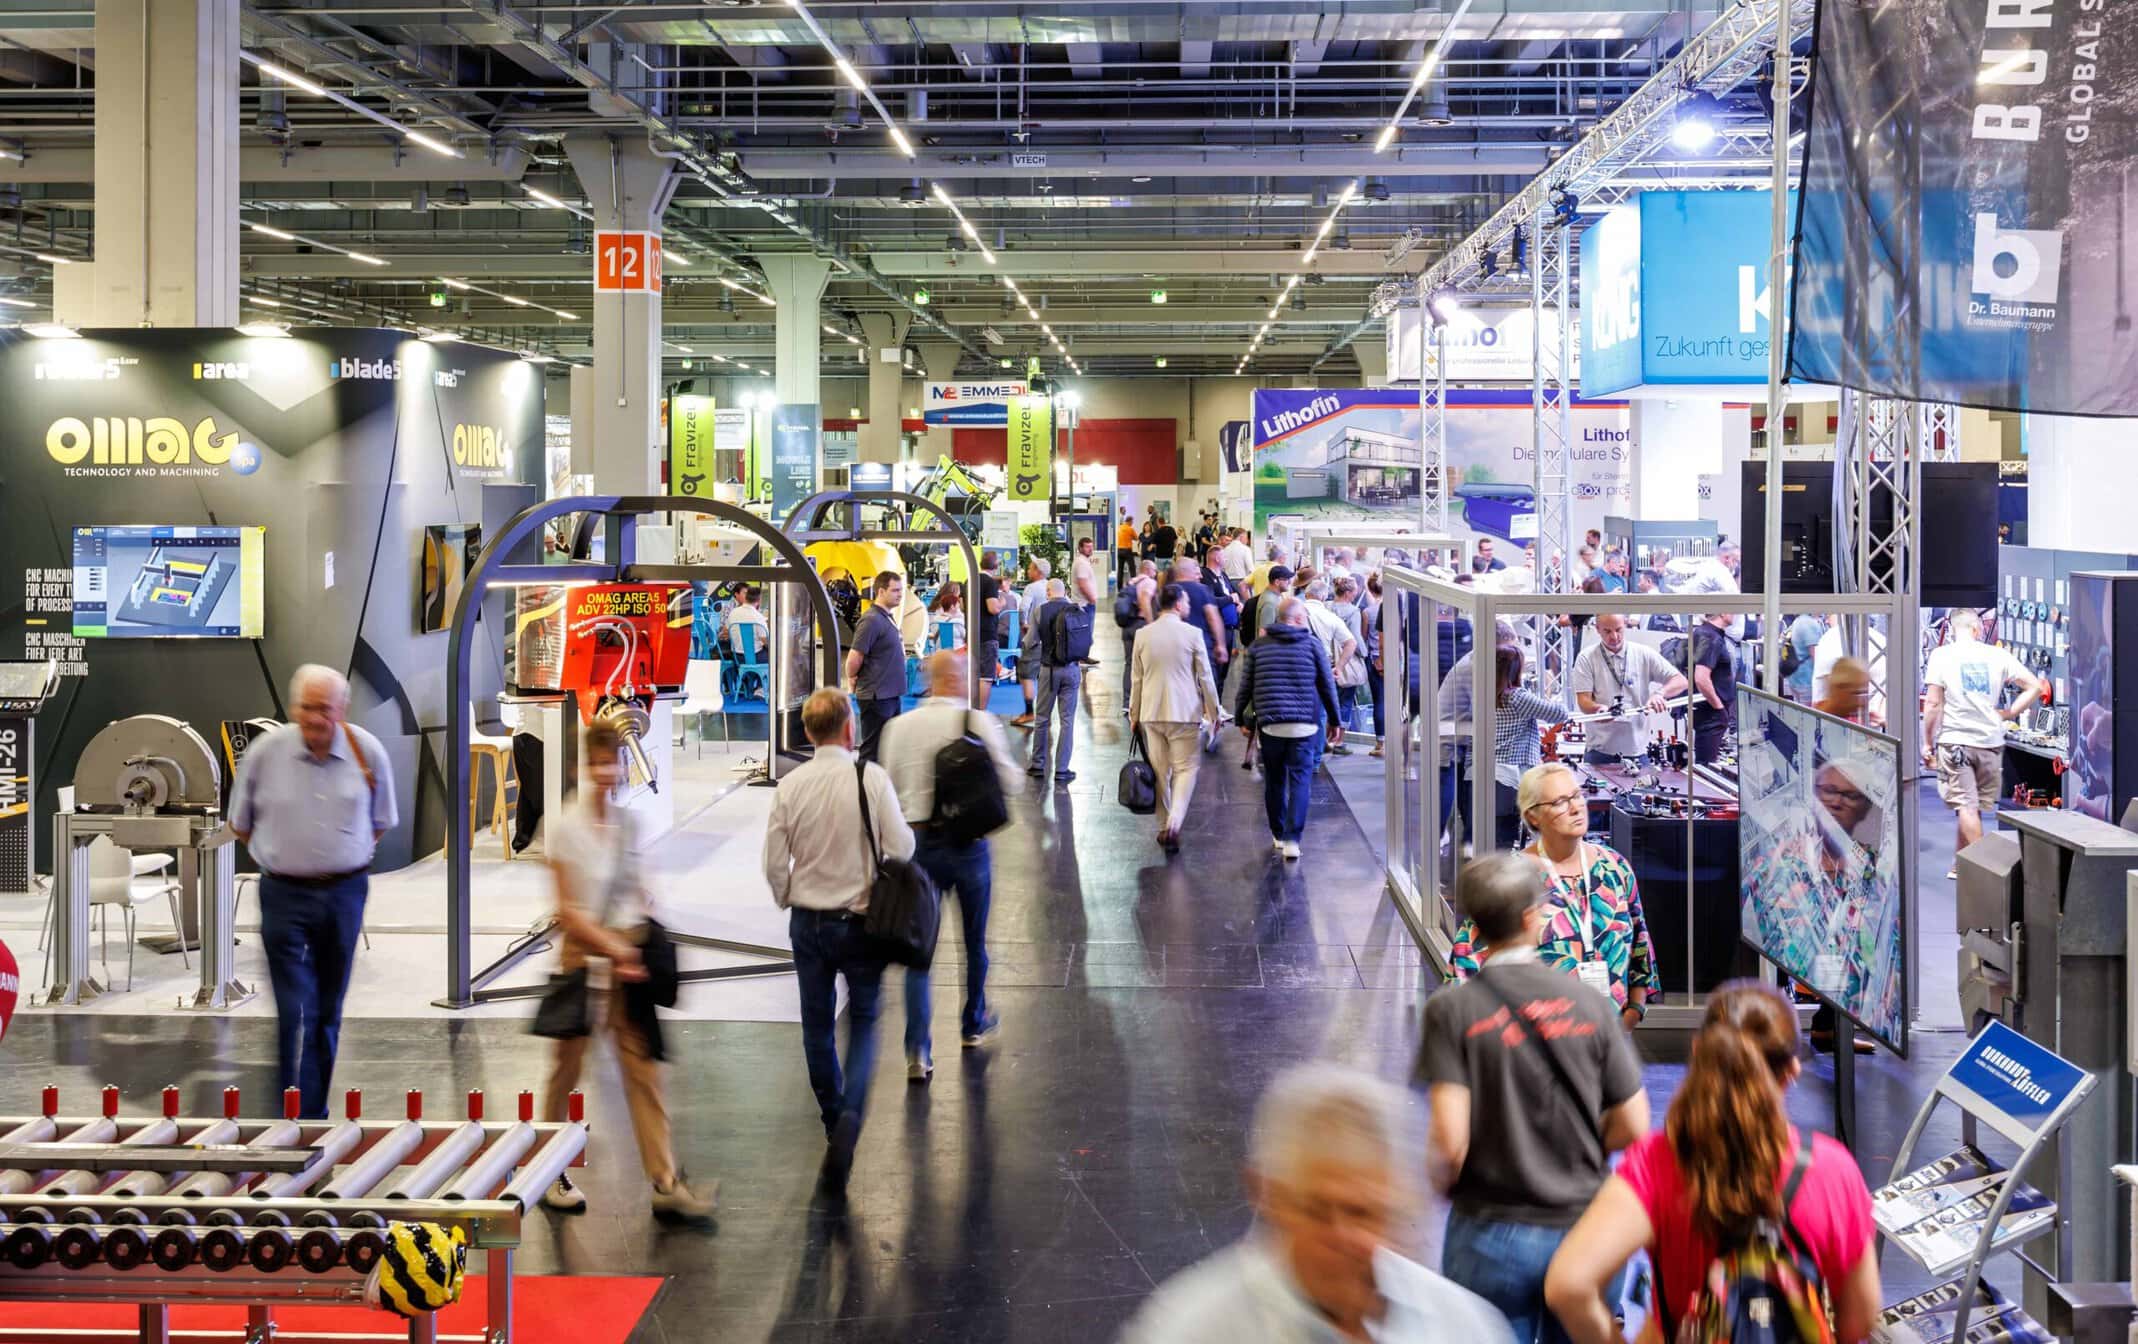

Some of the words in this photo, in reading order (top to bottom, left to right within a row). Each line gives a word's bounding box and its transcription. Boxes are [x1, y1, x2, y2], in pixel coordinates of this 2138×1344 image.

[2065, 21, 2103, 144] GLOBAL
[1015, 156, 1045, 164] VTECH
[604, 246, 638, 278] 12
[1968, 302, 1987, 315] Dr.
[1990, 302, 2056, 319] Baumann
[1655, 336, 1734, 357] Zukunft
[1739, 340, 1770, 361] ges
[1262, 396, 1340, 438] Lithofin
[1583, 428, 1630, 441] Lithof
[1611, 447, 1629, 463] Sy
[64, 467, 131, 477] TECHNOLOGY
[135, 467, 156, 477] AND
[160, 467, 220, 477] MACHINING
[26, 569, 41, 582] CNC
[26, 584, 40, 597] FOR
[42, 584, 64, 597] EVERY
[26, 598, 35, 611] OF
[587, 594, 620, 603] OMAG
[624, 593, 660, 603] AREA5
[577, 605, 600, 615] ADV
[603, 604, 630, 614] 22HP
[633, 603, 651, 614] ISO
[655, 603, 666, 613] 50
[26, 633, 40, 646] CNC
[68, 648, 82, 660] ART
